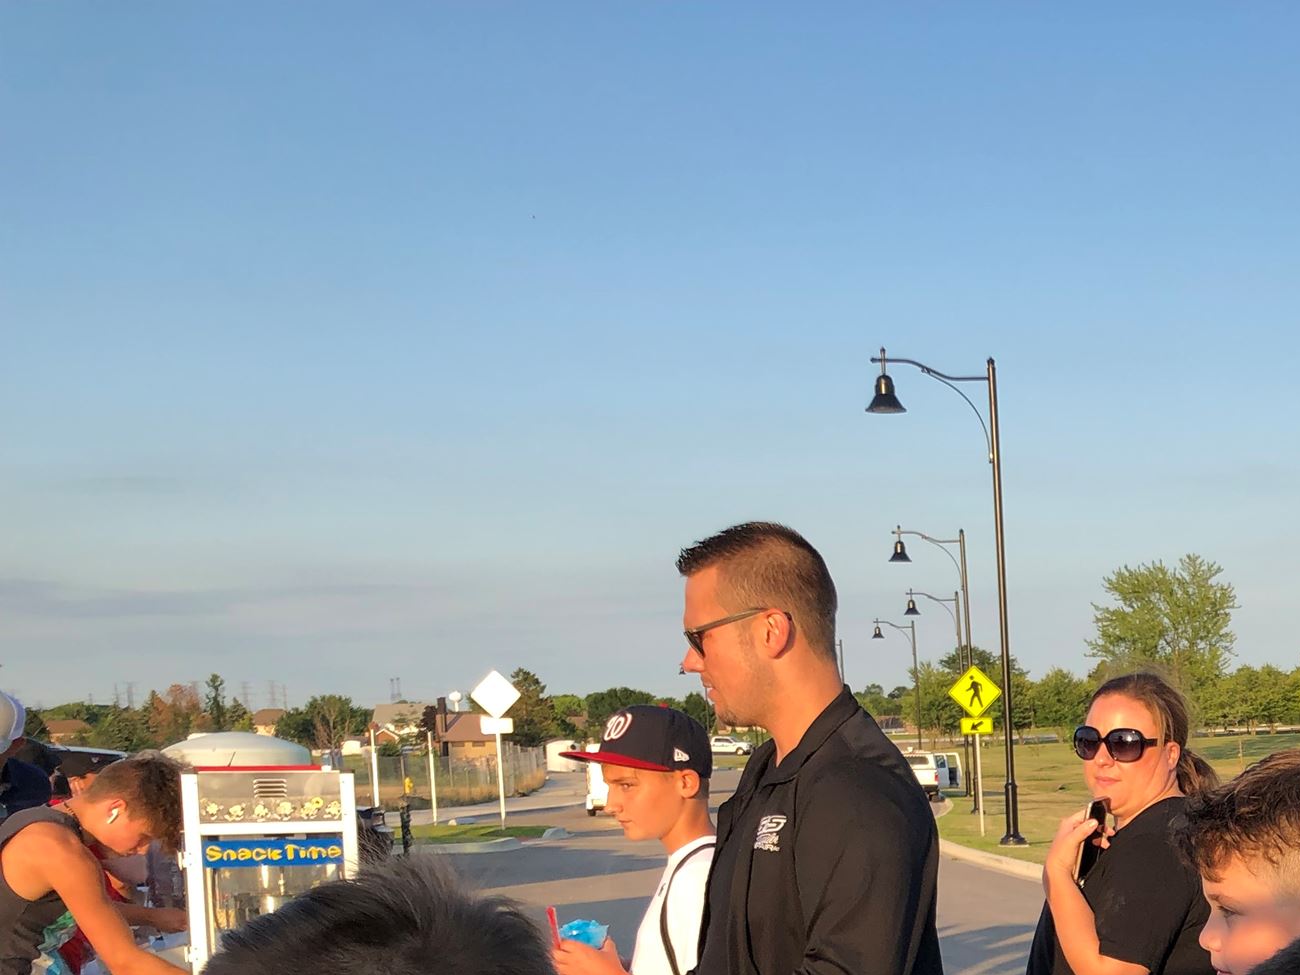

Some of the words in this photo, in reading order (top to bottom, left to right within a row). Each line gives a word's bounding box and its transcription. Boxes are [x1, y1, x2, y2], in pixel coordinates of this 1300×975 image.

[603, 712, 632, 741] W
[206, 845, 282, 862] Snack
[284, 844, 342, 860] Time
